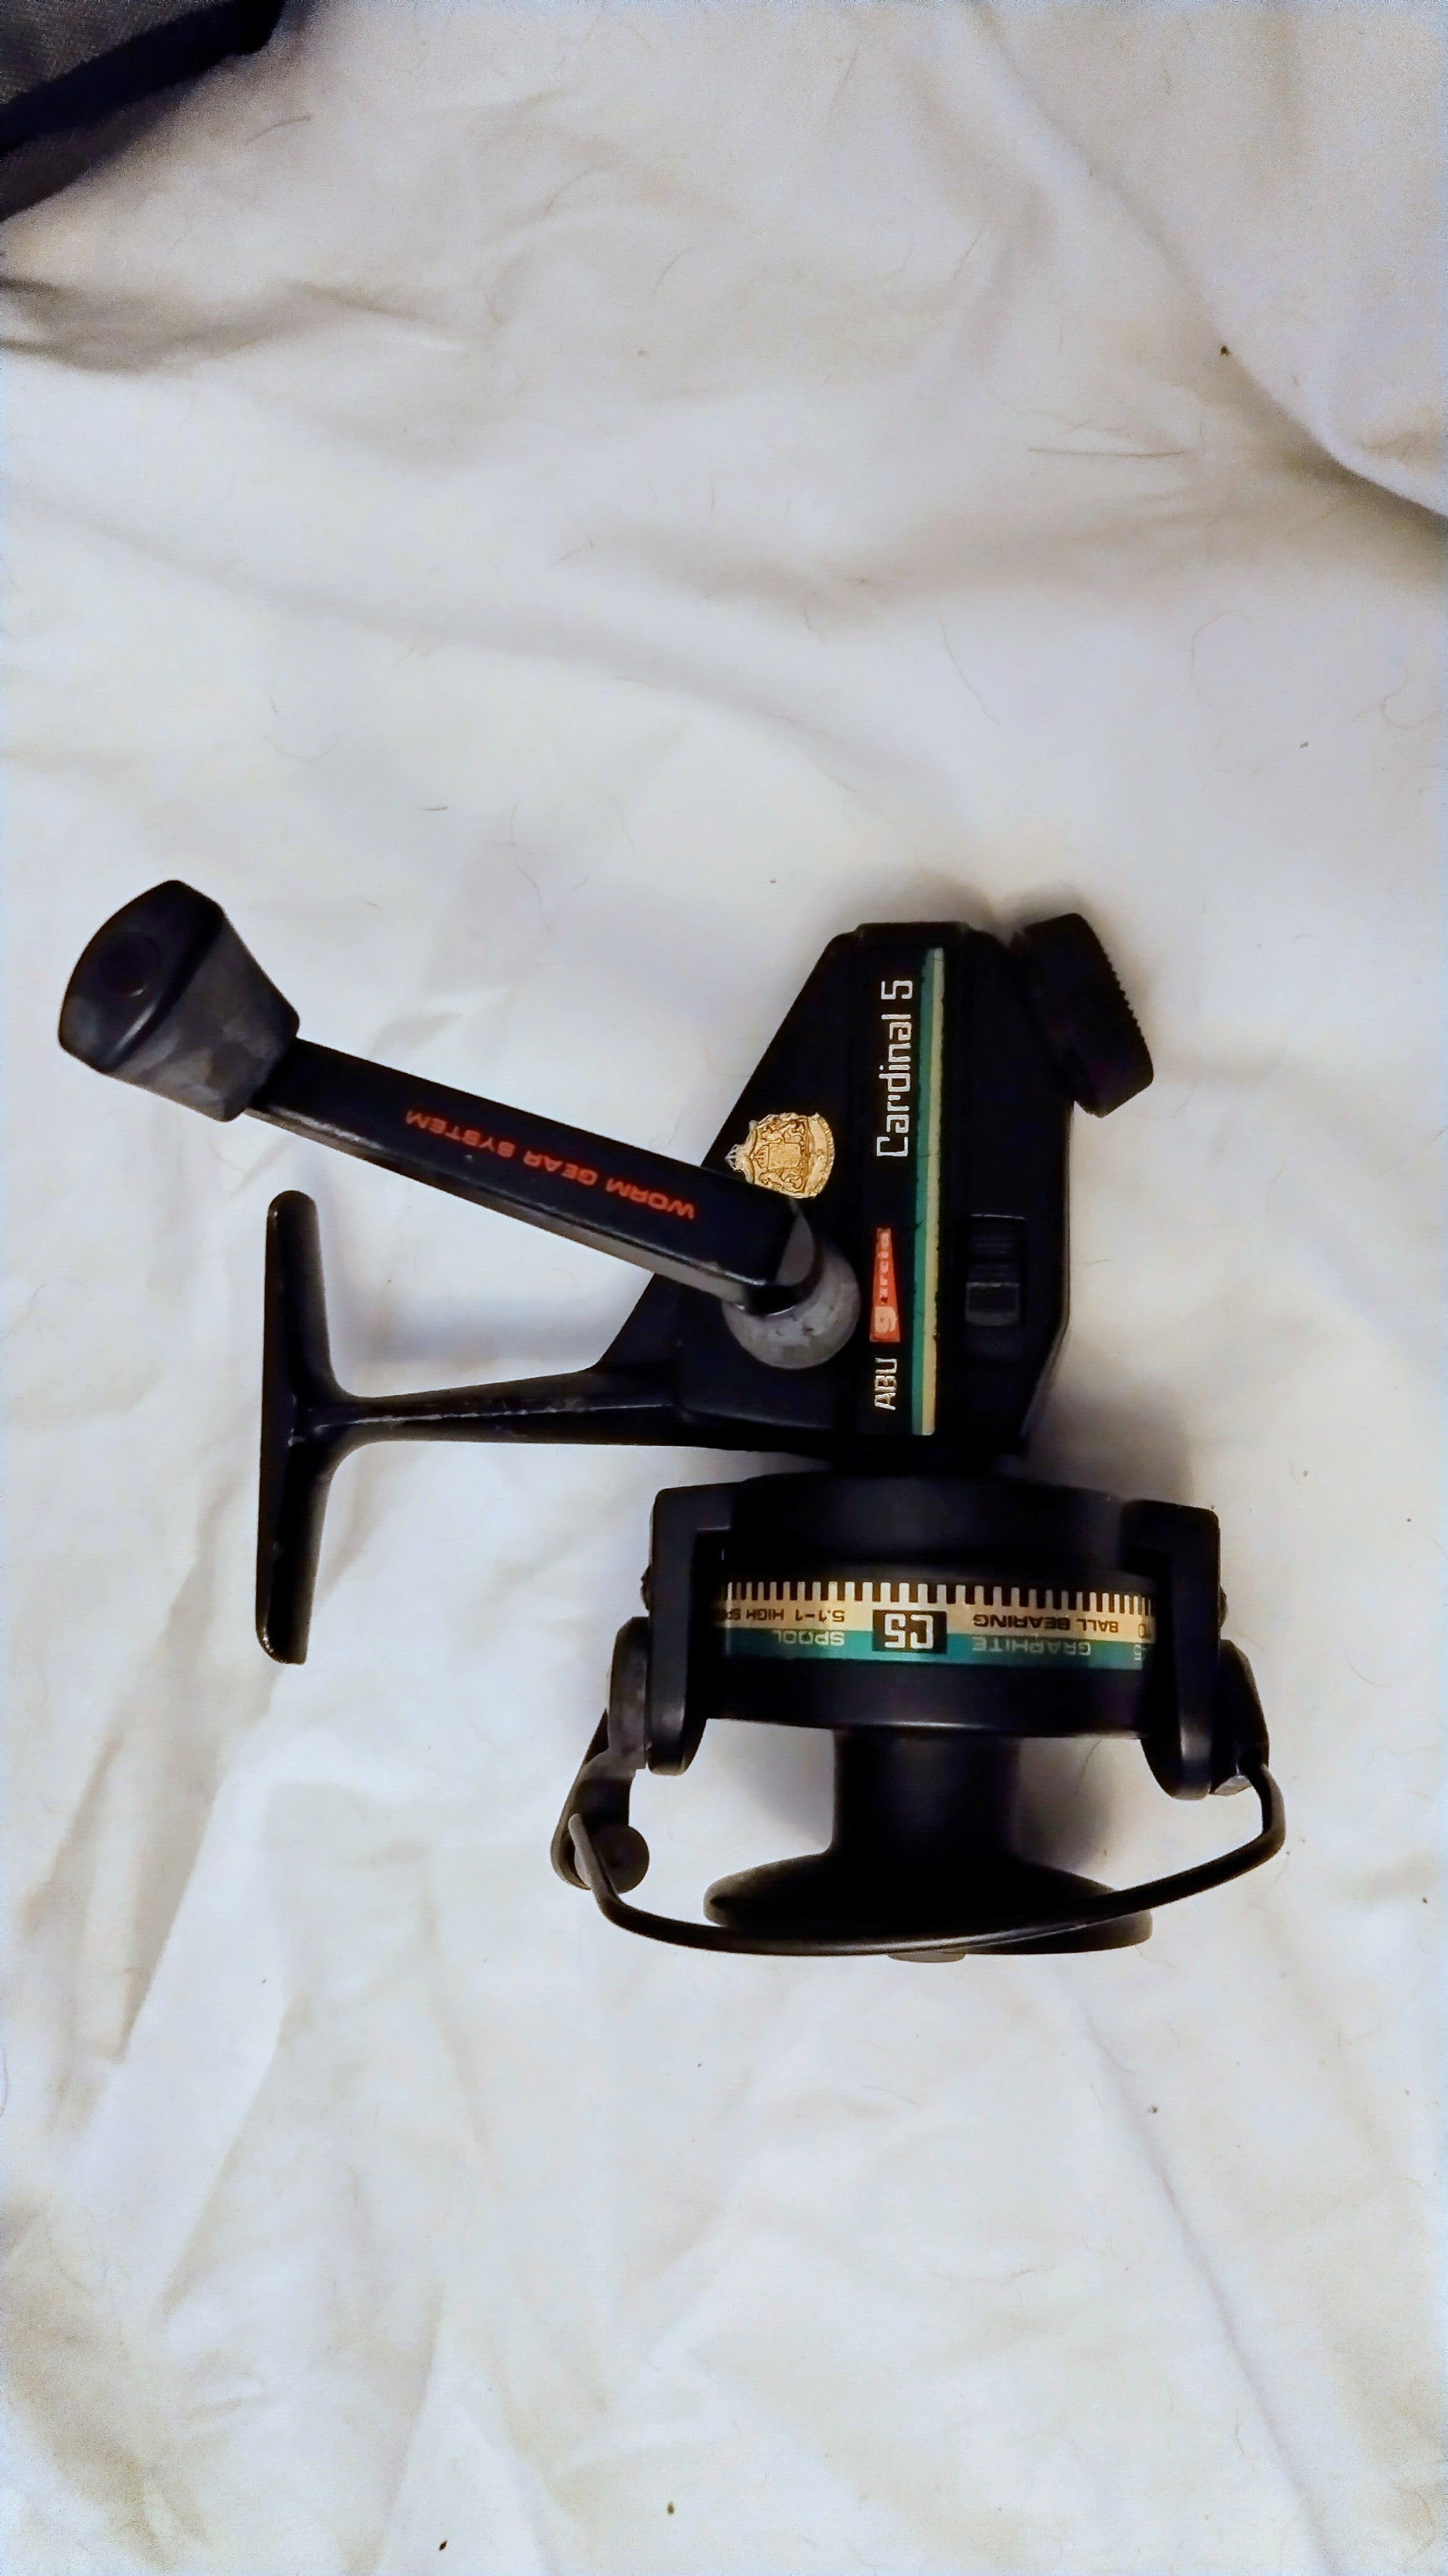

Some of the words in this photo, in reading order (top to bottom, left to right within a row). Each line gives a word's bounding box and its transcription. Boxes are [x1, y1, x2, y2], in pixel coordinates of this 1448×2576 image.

[881, 979, 914, 999] 5
[876, 1013, 913, 1157] Cardinal
[404, 1109, 515, 1158] SYSTEM
[523, 1149, 598, 1186] GEAR
[604, 1177, 696, 1220] WORM
[873, 1357, 898, 1410] ABU
[746, 1608, 785, 1621] HIGH
[795, 1609, 845, 1623] 5.1-1
[972, 1614, 1071, 1630] BEARING
[1076, 1618, 1119, 1633] BALL
[772, 1630, 845, 1647] SPOOL
[883, 1612, 935, 1650] C5
[972, 1635, 1092, 1657] GRAPHITE
